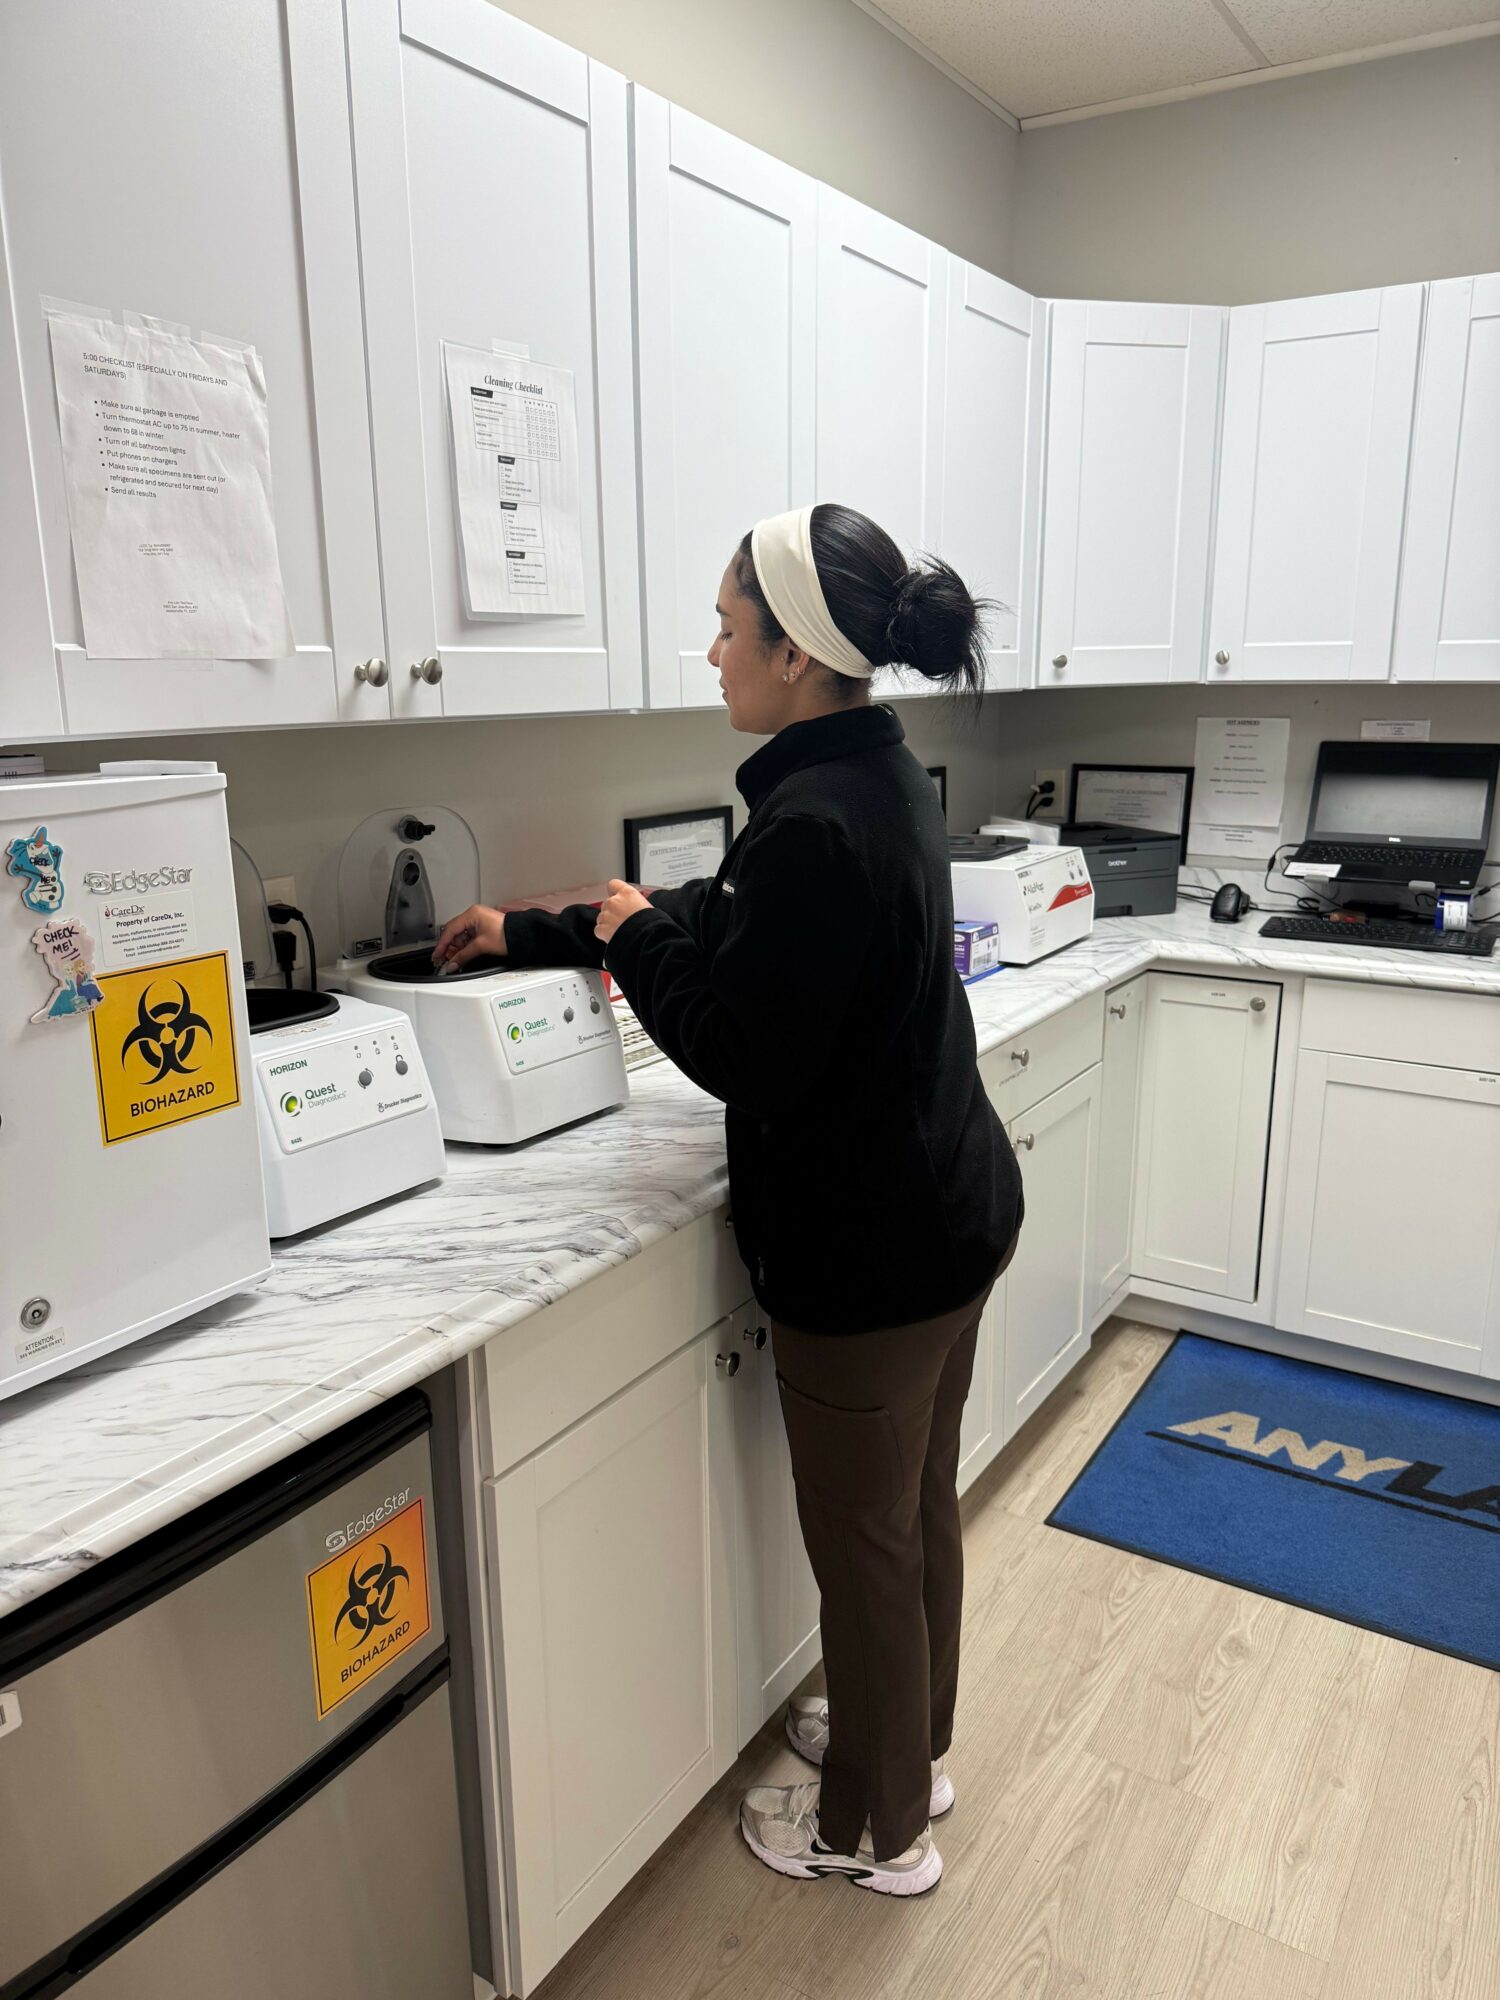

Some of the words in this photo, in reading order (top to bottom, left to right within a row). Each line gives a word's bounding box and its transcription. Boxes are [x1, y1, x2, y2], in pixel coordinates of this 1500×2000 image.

[83, 352, 98, 362] 5:00
[99, 355, 135, 368] CHECKLIST
[136, 363, 177, 377] (ESPECIALLY
[177, 370, 188, 379] ON
[188, 372, 214, 384] FRIDAYS
[214, 378, 228, 387] AND
[484, 375, 514, 390] Cleaning
[514, 382, 543, 395] Checklist
[100, 400, 119, 409] Make
[142, 407, 167, 418] garbage
[175, 412, 200, 421] emptied
[102, 412, 118, 420] Turn
[118, 414, 152, 426] thermostat
[152, 420, 162, 428] AC
[172, 423, 180, 431] to
[180, 424, 188, 432] 75
[196, 427, 221, 438] summer,
[103, 424, 122, 432] down
[145, 432, 164, 440] winter
[105, 436, 120, 445] Turn
[139, 442, 169, 453] bathroom
[169, 446, 187, 455] lights
[107, 449, 119, 458] Put
[120, 452, 142, 461] phones
[151, 456, 178, 466] chargers
[108, 462, 126, 471] Make
[126, 465, 140, 473] sure
[148, 468, 182, 479] specimens
[193, 473, 206, 481] sent
[109, 474, 144, 487] refrigerated
[145, 478, 157, 486] and
[157, 480, 182, 489] secured
[206, 486, 219, 495] day)
[111, 486, 127, 495] Send
[136, 490, 157, 499] results
[111, 866, 192, 894] EdgeStar
[110, 904, 145, 918] CareDx
[116, 918, 143, 928] Property
[143, 916, 150, 924] of
[150, 913, 173, 922] CareDx,
[44, 926, 79, 944] CHECK
[52, 941, 73, 954] ME!
[498, 997, 527, 1010] HORIZON
[524, 1017, 548, 1031] Quest
[527, 1026, 553, 1038] Diagnostics
[269, 1059, 308, 1077] HORIZON
[131, 1081, 215, 1117] BIOHAZARD
[305, 1083, 337, 1100] Quest
[308, 1091, 347, 1109] Diagnostics
[400, 1093, 422, 1104] Diagnostics
[25, 1335, 54, 1351] ATTENTION
[346, 1487, 410, 1542] EdgeStar
[340, 1619, 411, 1683] BIOHAZARD
